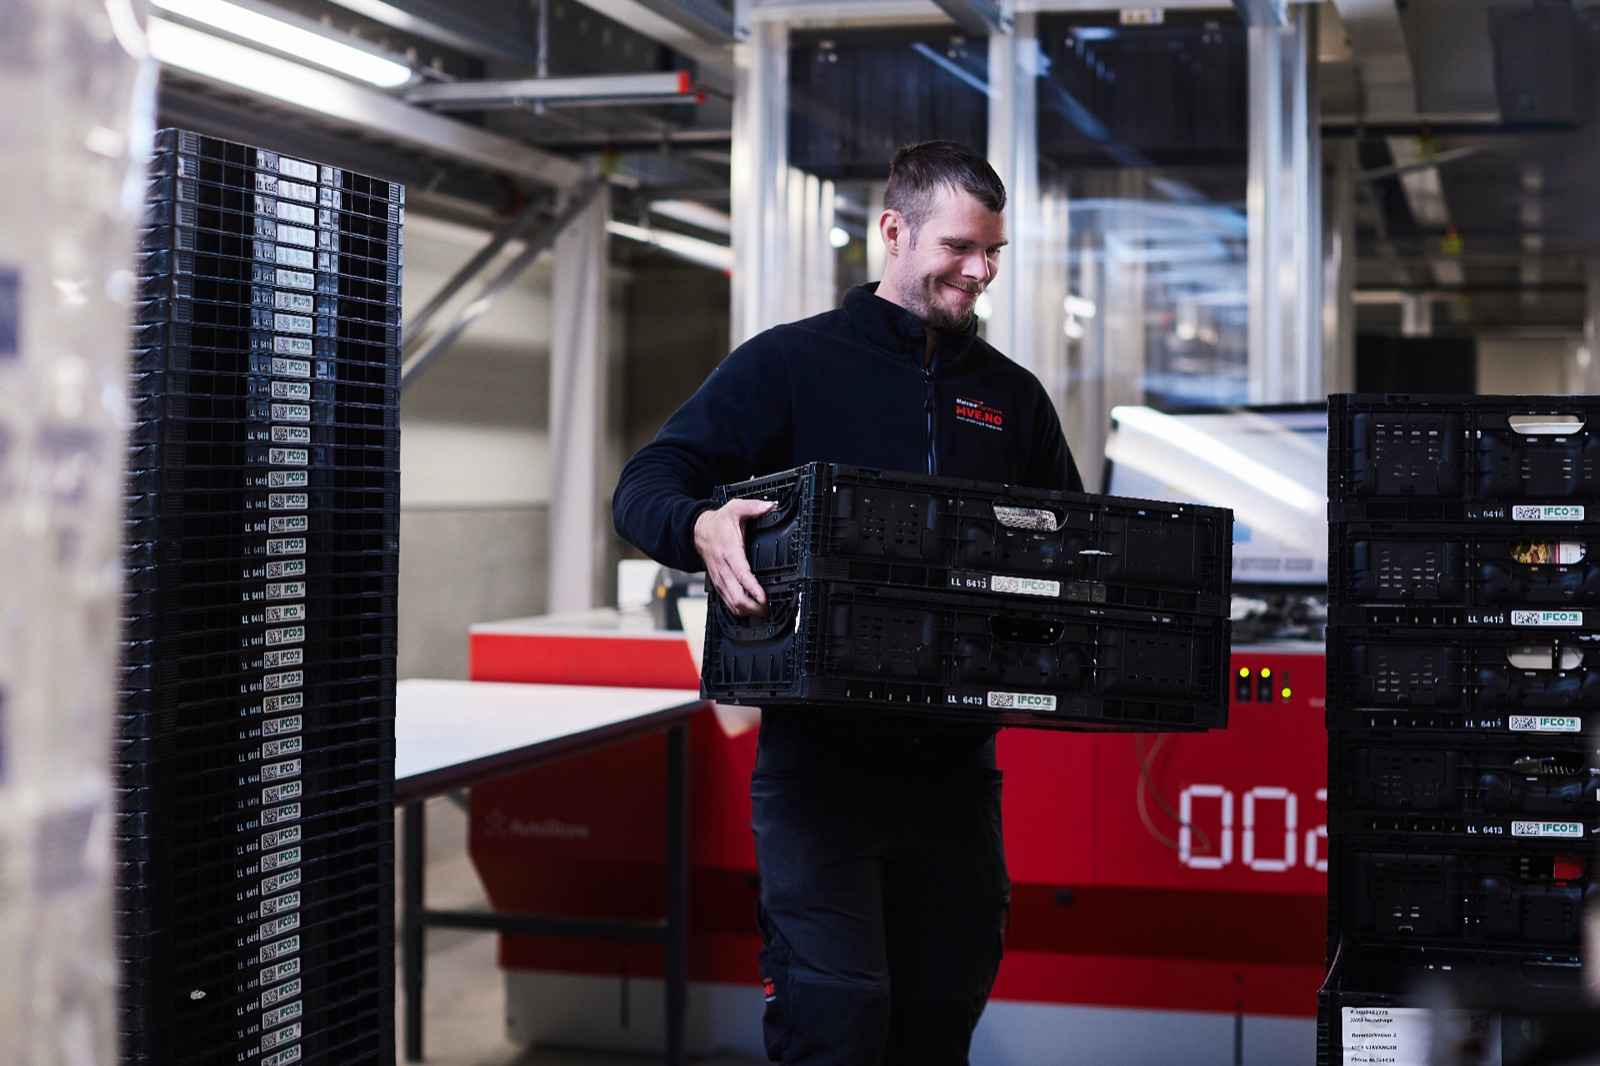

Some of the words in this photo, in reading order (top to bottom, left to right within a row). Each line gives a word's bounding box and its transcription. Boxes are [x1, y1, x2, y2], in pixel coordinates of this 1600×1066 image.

[289, 384, 304, 393] IFCO
[289, 406, 302, 415] IFCO
[288, 428, 302, 438] IFCO
[287, 451, 301, 459] IFCO
[286, 496, 300, 504] IFCO
[1544, 507, 1568, 516] IFCO
[285, 540, 298, 549] IFCO
[284, 562, 297, 571] IFCO
[284, 584, 298, 593] IFCO
[951, 578, 960, 586] LL
[1022, 580, 1046, 590] IFCO
[283, 607, 297, 616] IFCO
[1542, 613, 1568, 621] IFCO
[283, 628, 297, 638] IFCO
[281, 652, 294, 661] IFCO
[281, 674, 295, 683] IFCO
[281, 696, 294, 705] IFCO
[947, 695, 957, 703] LL
[963, 696, 983, 705] 6413
[1018, 695, 1042, 705] IFCO
[280, 719, 294, 728] IFCO
[1540, 718, 1565, 726] IFCO
[280, 741, 294, 750] IFCO
[280, 763, 294, 772] IFCO
[280, 784, 294, 794] IFCO
[279, 806, 292, 816] IFCO
[1467, 826, 1476, 834] LL
[1483, 826, 1502, 834] 6413
[1543, 824, 1568, 832] IFCO
[280, 830, 293, 839] IFCO
[279, 852, 293, 860] IFCO
[280, 874, 293, 884] IFCO
[279, 896, 293, 906] IFCO
[278, 939, 291, 951] IFCO
[278, 962, 292, 974] IFCO
[279, 982, 292, 995] IFCO
[280, 1004, 293, 1018] IFCO
[280, 1027, 294, 1039] IFCO
[279, 1050, 294, 1062] IFCO
